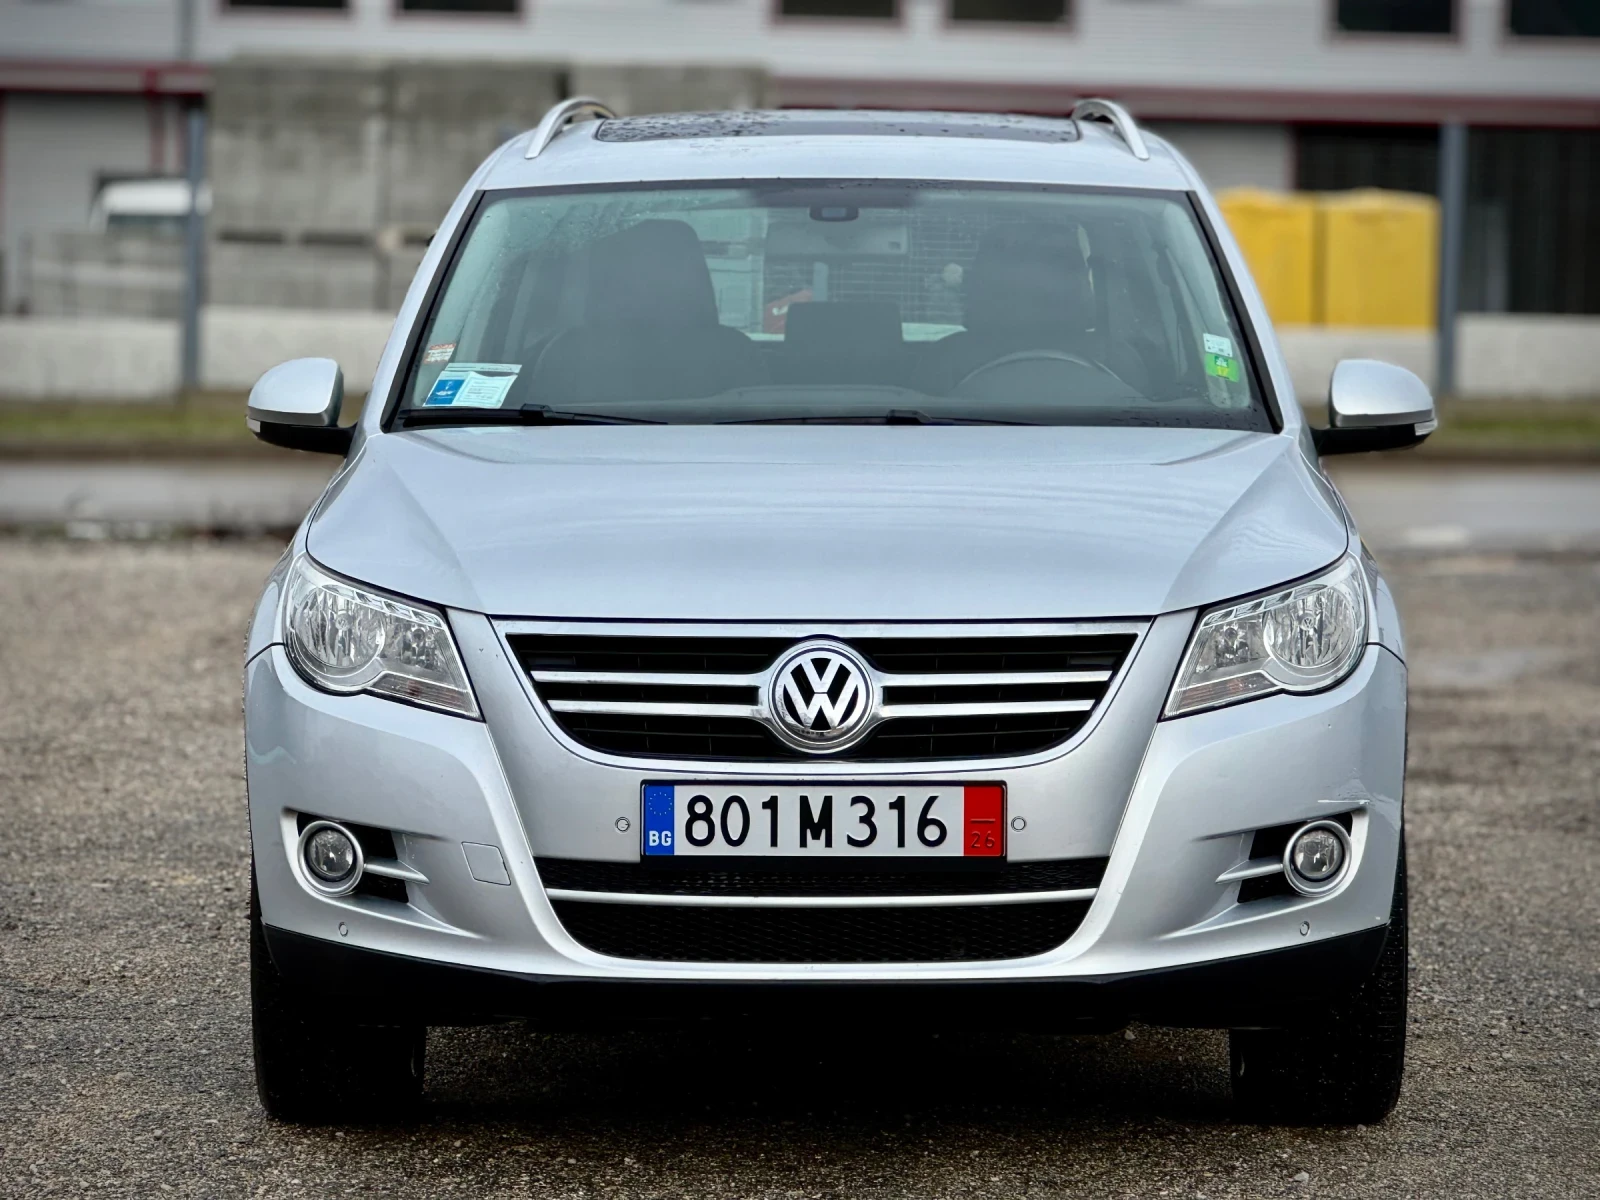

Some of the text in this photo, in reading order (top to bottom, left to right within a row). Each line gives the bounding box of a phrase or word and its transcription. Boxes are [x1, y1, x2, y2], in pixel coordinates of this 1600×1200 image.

[775, 651, 866, 737] VW
[649, 830, 672, 847] BG
[970, 830, 995, 848] 26
